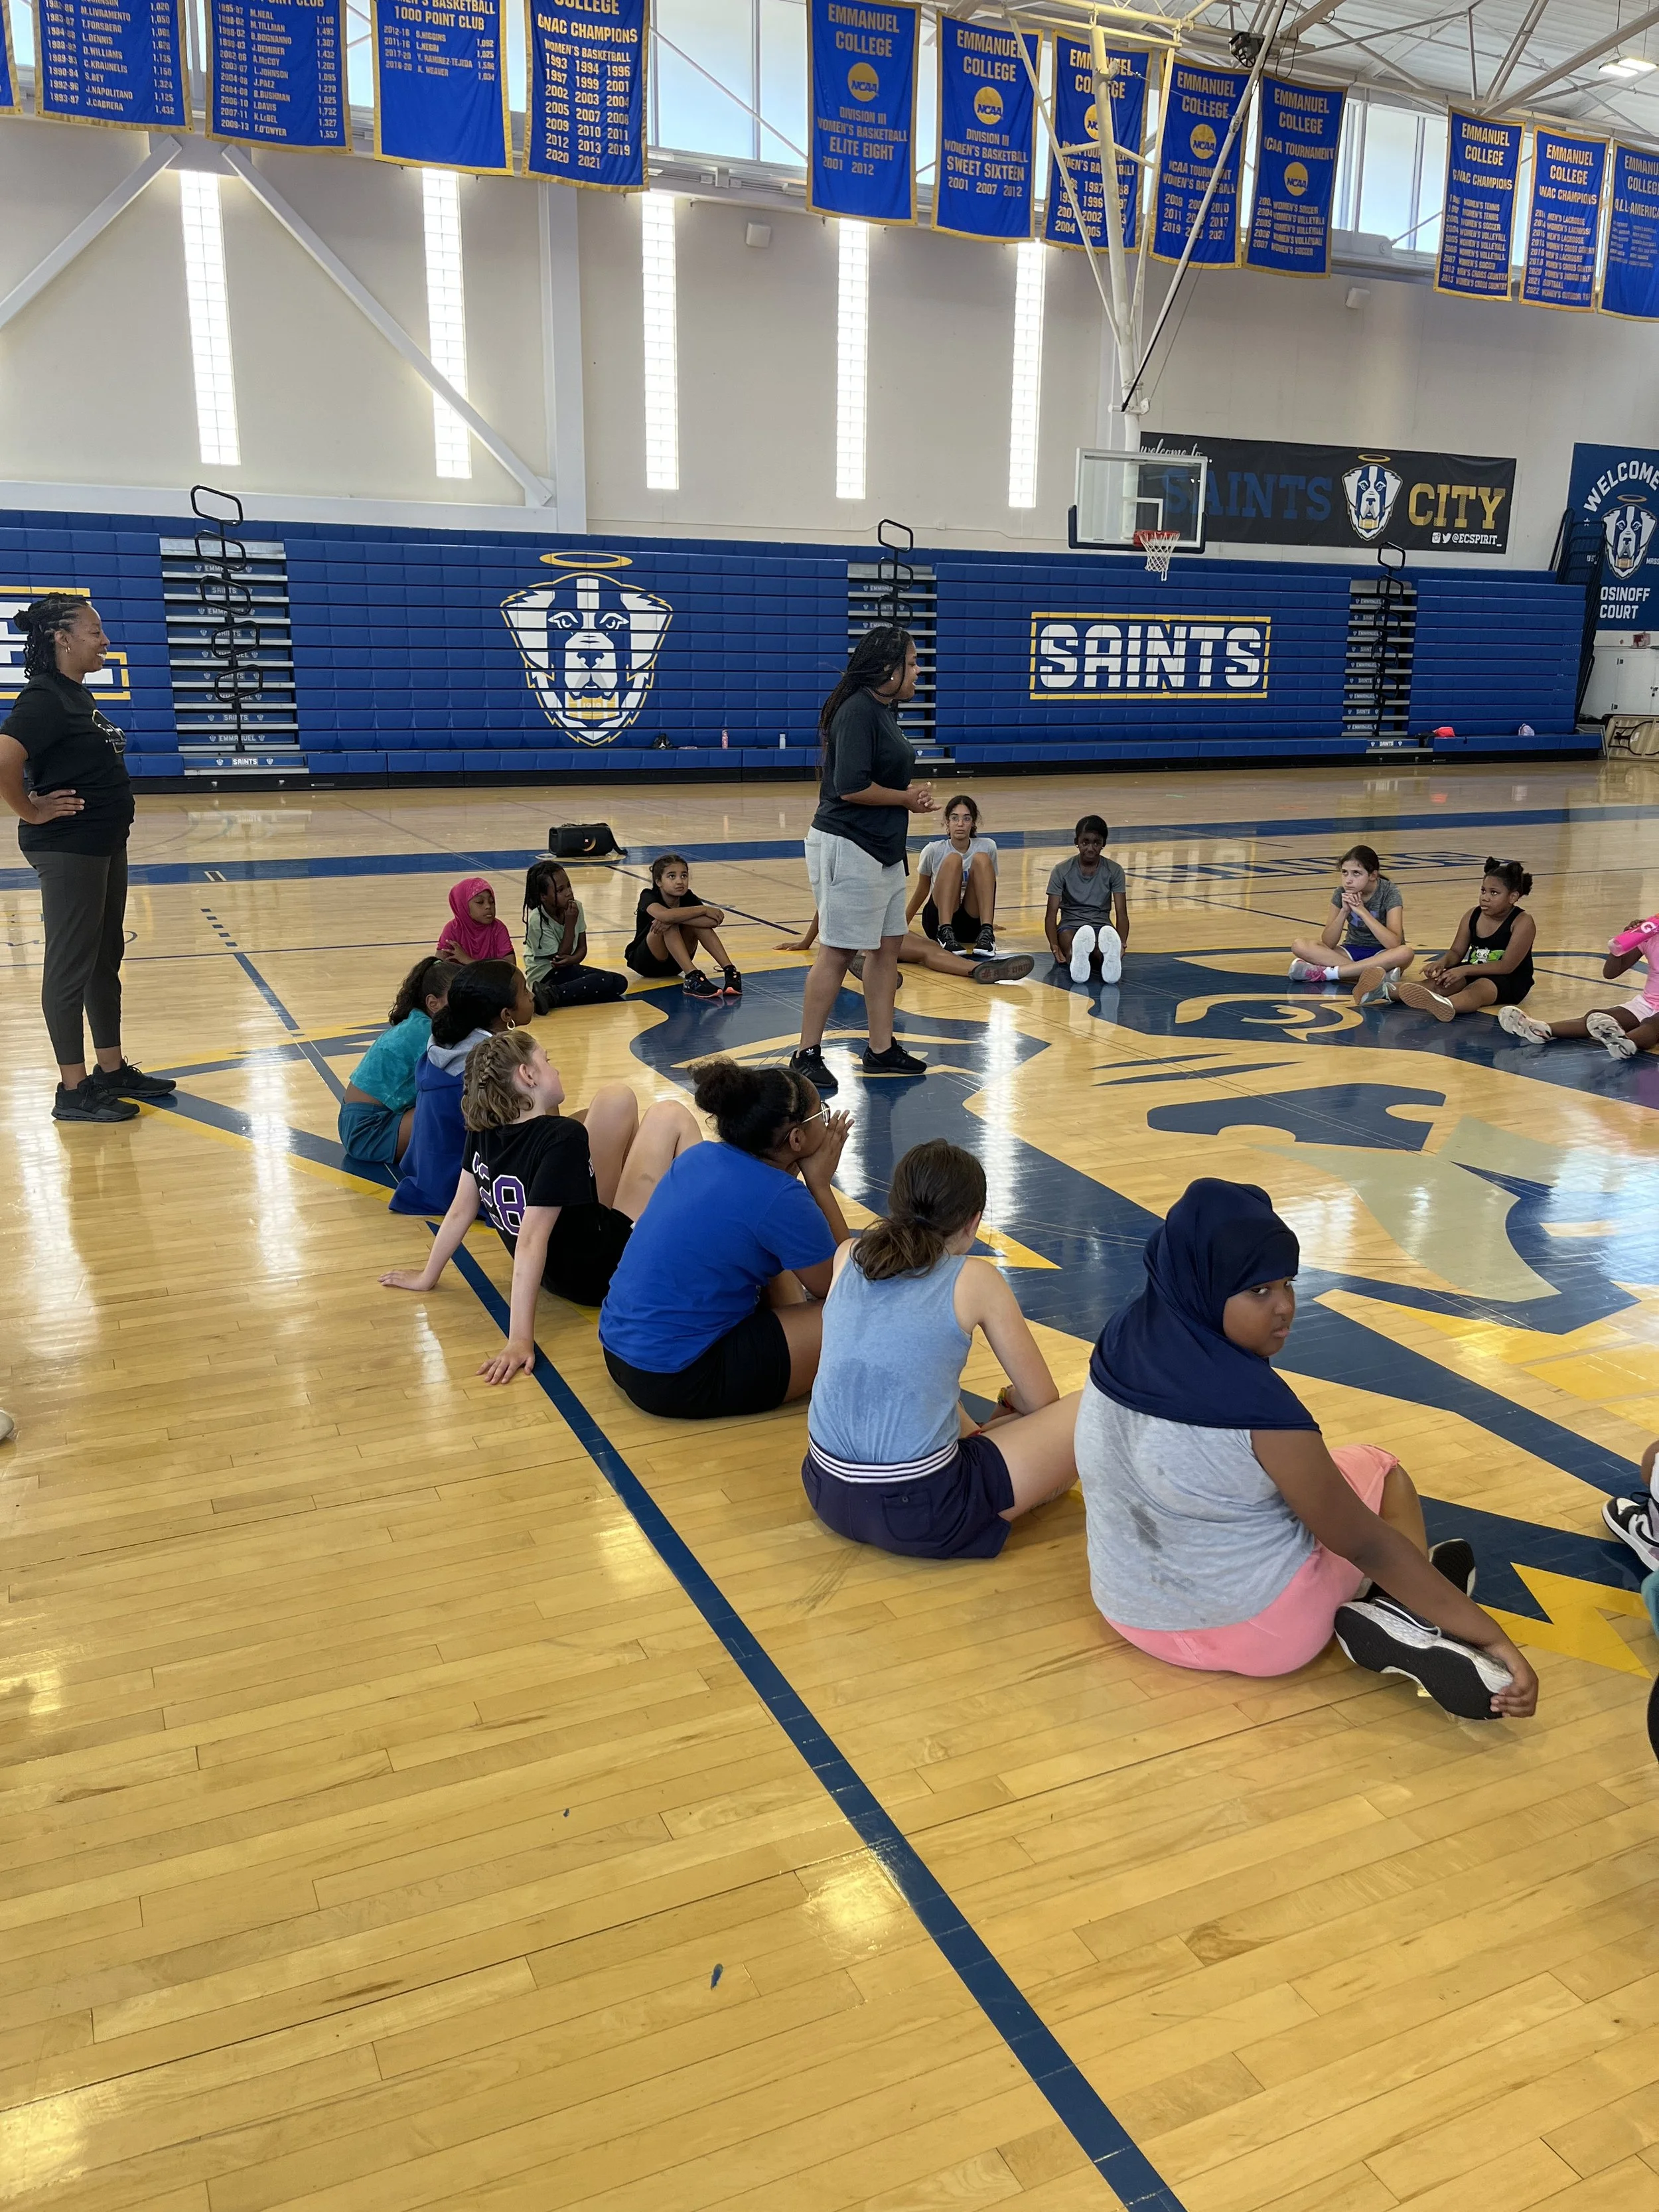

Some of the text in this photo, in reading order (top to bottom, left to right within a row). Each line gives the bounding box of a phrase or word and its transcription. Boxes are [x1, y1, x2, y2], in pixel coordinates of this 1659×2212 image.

[394, 5, 485, 31] 1000 POINT CLUB
[538, 13, 638, 44] GNAC CHAMPIONS
[828, 3, 900, 33] EMMANUEL
[543, 38, 631, 63] WOMEN'S BASKETBALL
[835, 31, 893, 58] COLLEGE
[545, 52, 630, 77] 1993 1994 1996
[964, 56, 1017, 82] COLLEGE
[545, 68, 629, 92] 1997 1999 2001
[851, 80, 877, 93] NCAA
[1177, 70, 1236, 98] EMMANUEL
[545, 84, 629, 108] 2002 2003 2004
[1182, 96, 1229, 119] COLLEGE
[1274, 88, 1330, 113] EMMANUEL
[545, 102, 629, 125] 2005 2007 2008
[839, 106, 887, 125] DIVISION III
[977, 104, 1002, 117] NCAA
[545, 117, 628, 141] 2009 2010 2011
[817, 115, 908, 142] WOMEN'S BASKETBALL
[1279, 111, 1324, 135] COLLEGE
[1461, 122, 1510, 147] EMMANUEL
[545, 133, 630, 156] 2012 2013 2019
[966, 128, 999, 145] DIVISION
[1193, 139, 1215, 151] NCAA
[545, 148, 601, 169] 2020 2021
[830, 136, 895, 161] ELITE EIGHT
[944, 139, 1029, 163] WOMEN'S BASKETBALL
[1285, 141, 1334, 160] TOURNAMENT
[1465, 145, 1504, 166] COLLEGE
[1546, 143, 1593, 167] EMMANUEL
[823, 156, 875, 176] 2001 2012
[947, 156, 1025, 181] SWEET SIXTEEN
[1550, 165, 1589, 185] COLLEGE
[1624, 155, 1659, 176] EMMANU
[948, 176, 1023, 197] 2001 2007 2012
[1163, 173, 1194, 189] WOMEN'S
[1287, 178, 1307, 188] NCAA
[1473, 174, 1512, 190] CHAMPIONS
[1557, 189, 1597, 205] CHAMPIONS
[1082, 211, 1102, 223] 2002
[1164, 208, 1181, 221] 2011
[1055, 220, 1075, 234] 2004
[1162, 222, 1225, 240] 2019 2021
[1583, 460, 1659, 512] WELCOME
[1409, 482, 1506, 530] CITY
[1452, 533, 1502, 547] @ECSPIRIT_
[1600, 586, 1650, 601] OSINOFF
[1599, 605, 1639, 619] COURT
[1040, 625, 1261, 688] SAINTS
